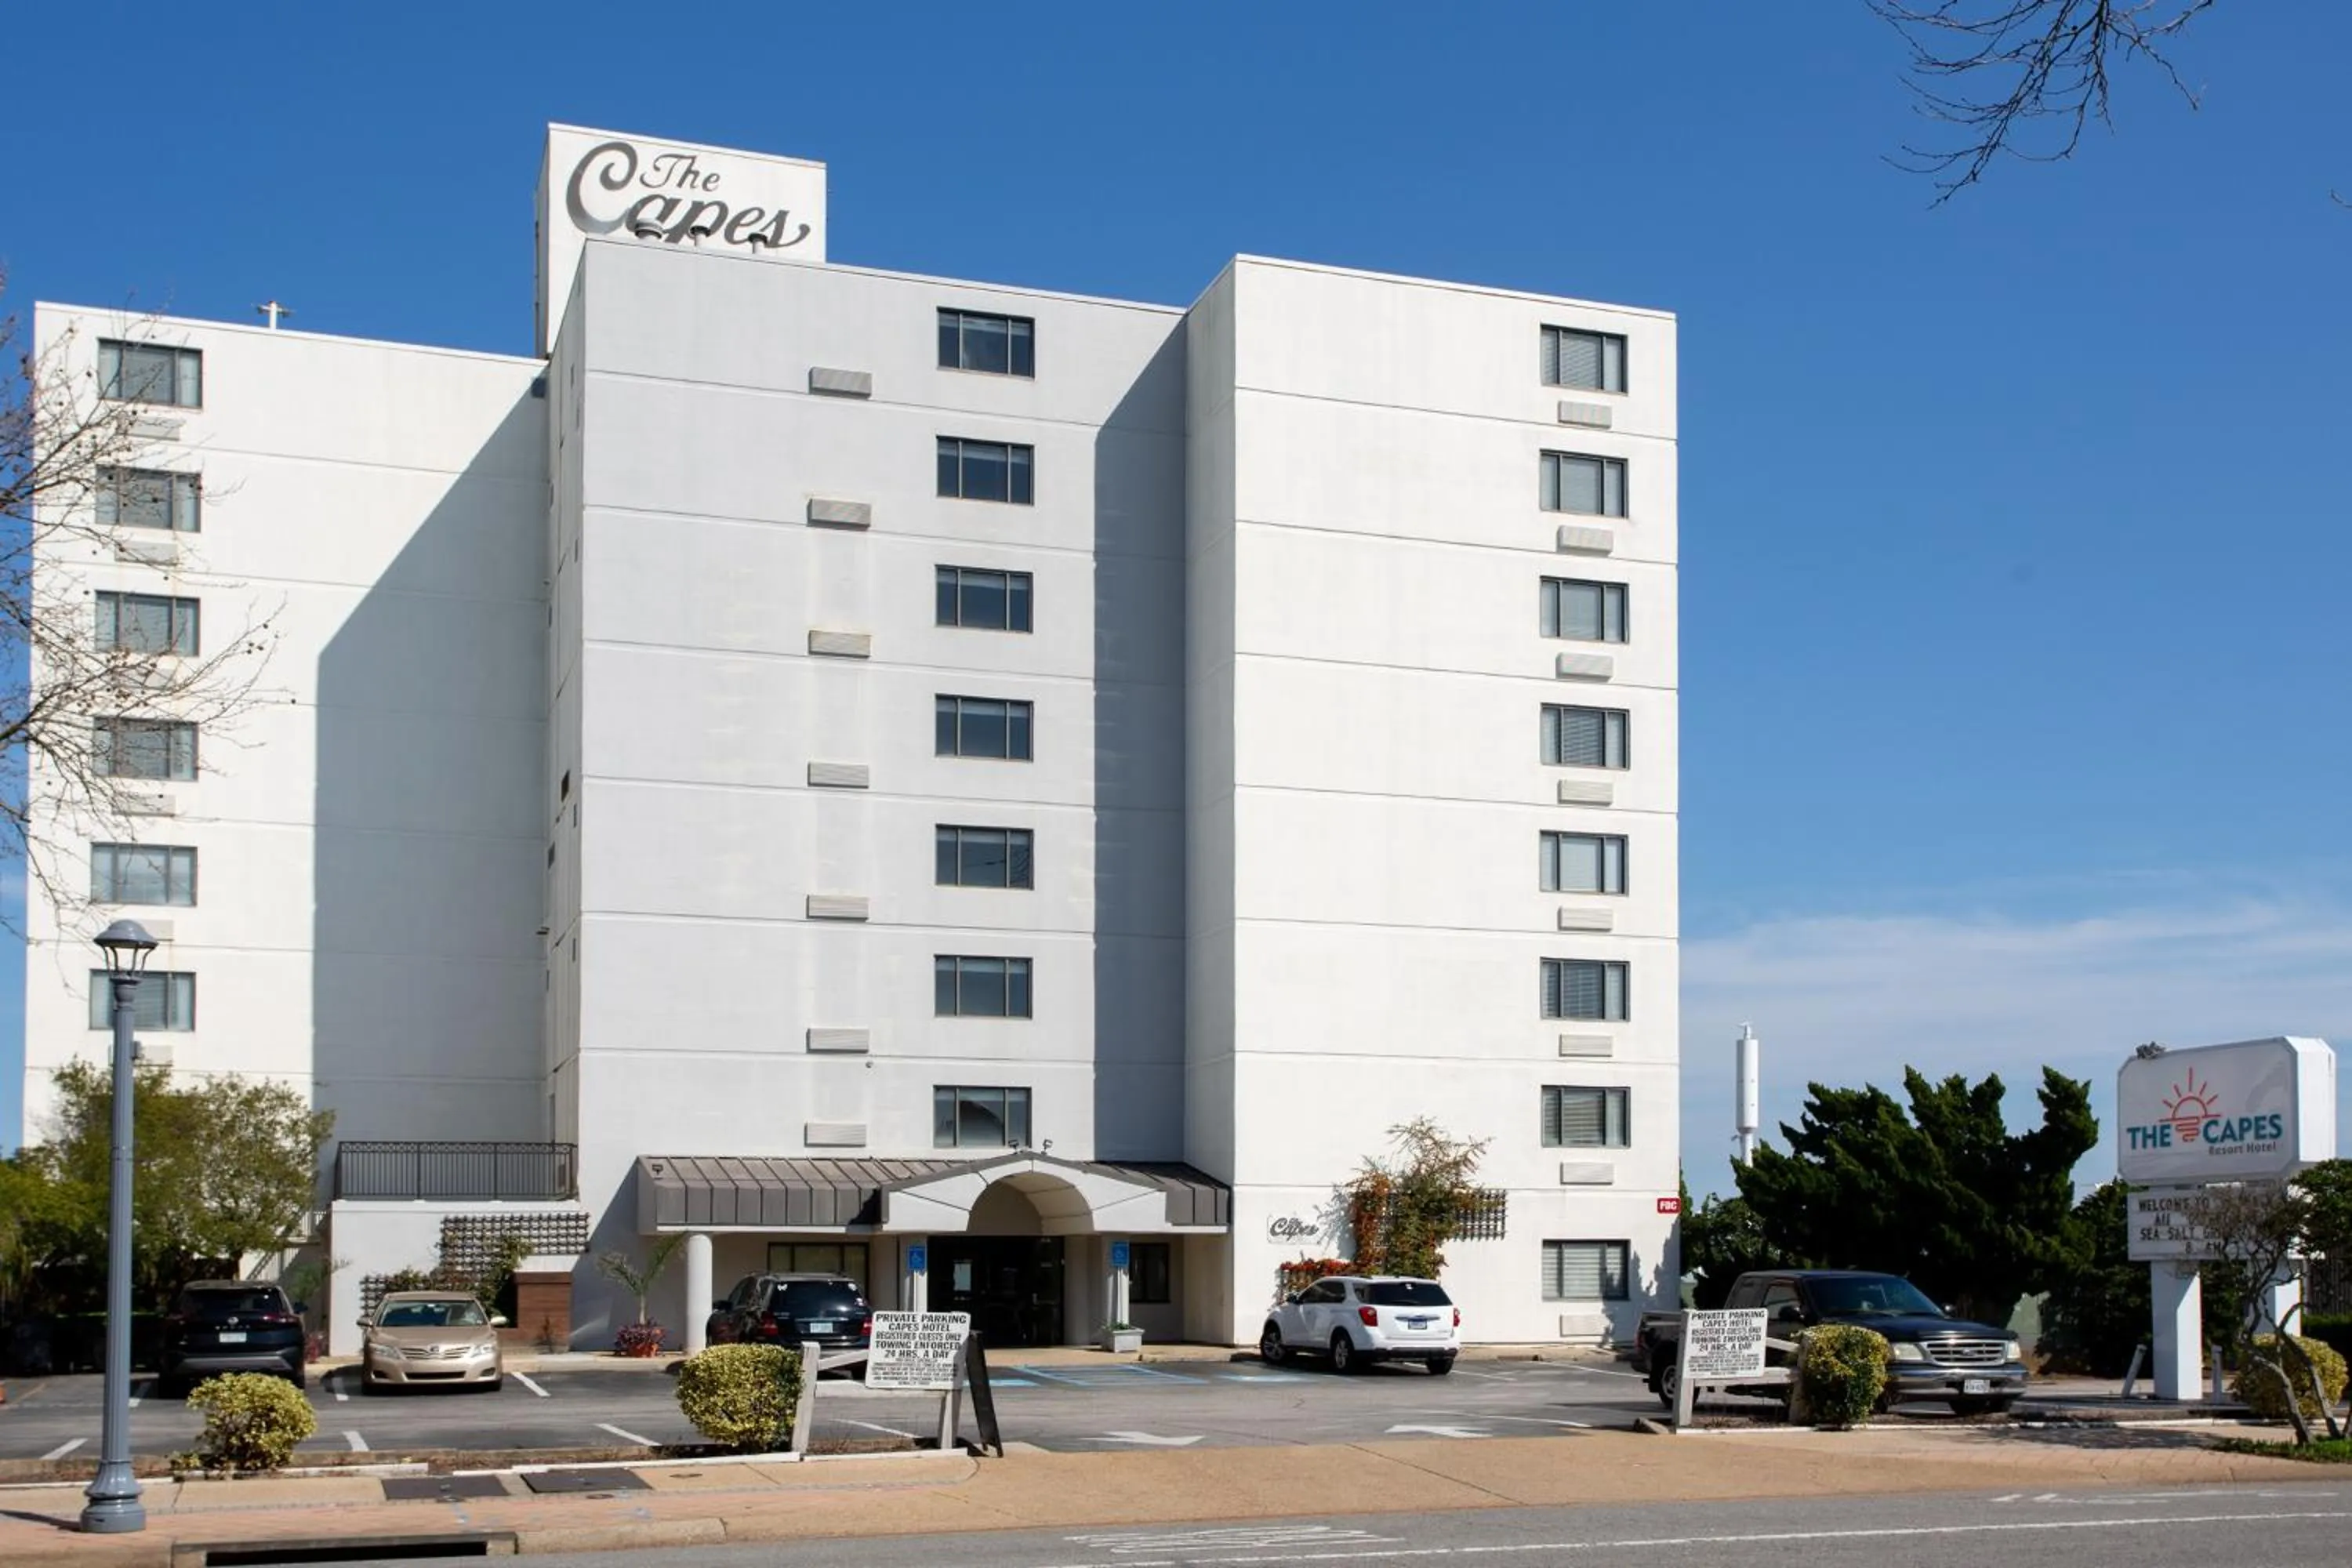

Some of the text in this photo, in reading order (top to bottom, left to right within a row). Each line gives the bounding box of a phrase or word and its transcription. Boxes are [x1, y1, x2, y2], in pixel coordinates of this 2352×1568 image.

[639, 154, 721, 192] The
[565, 141, 811, 249] Capes
[2126, 1113, 2282, 1150] THE CAPES
[2209, 1142, 2277, 1156] Resort Hotel
[2140, 1227, 2160, 1241] SEA
[2167, 1226, 2195, 1241] SALT
[876, 1313, 967, 1323] PRIVATE PARKING
[1691, 1310, 1765, 1320] PRIVATE PARKING
[888, 1323, 950, 1332] CAPES HOTEL
[884, 1349, 896, 1358] 24
